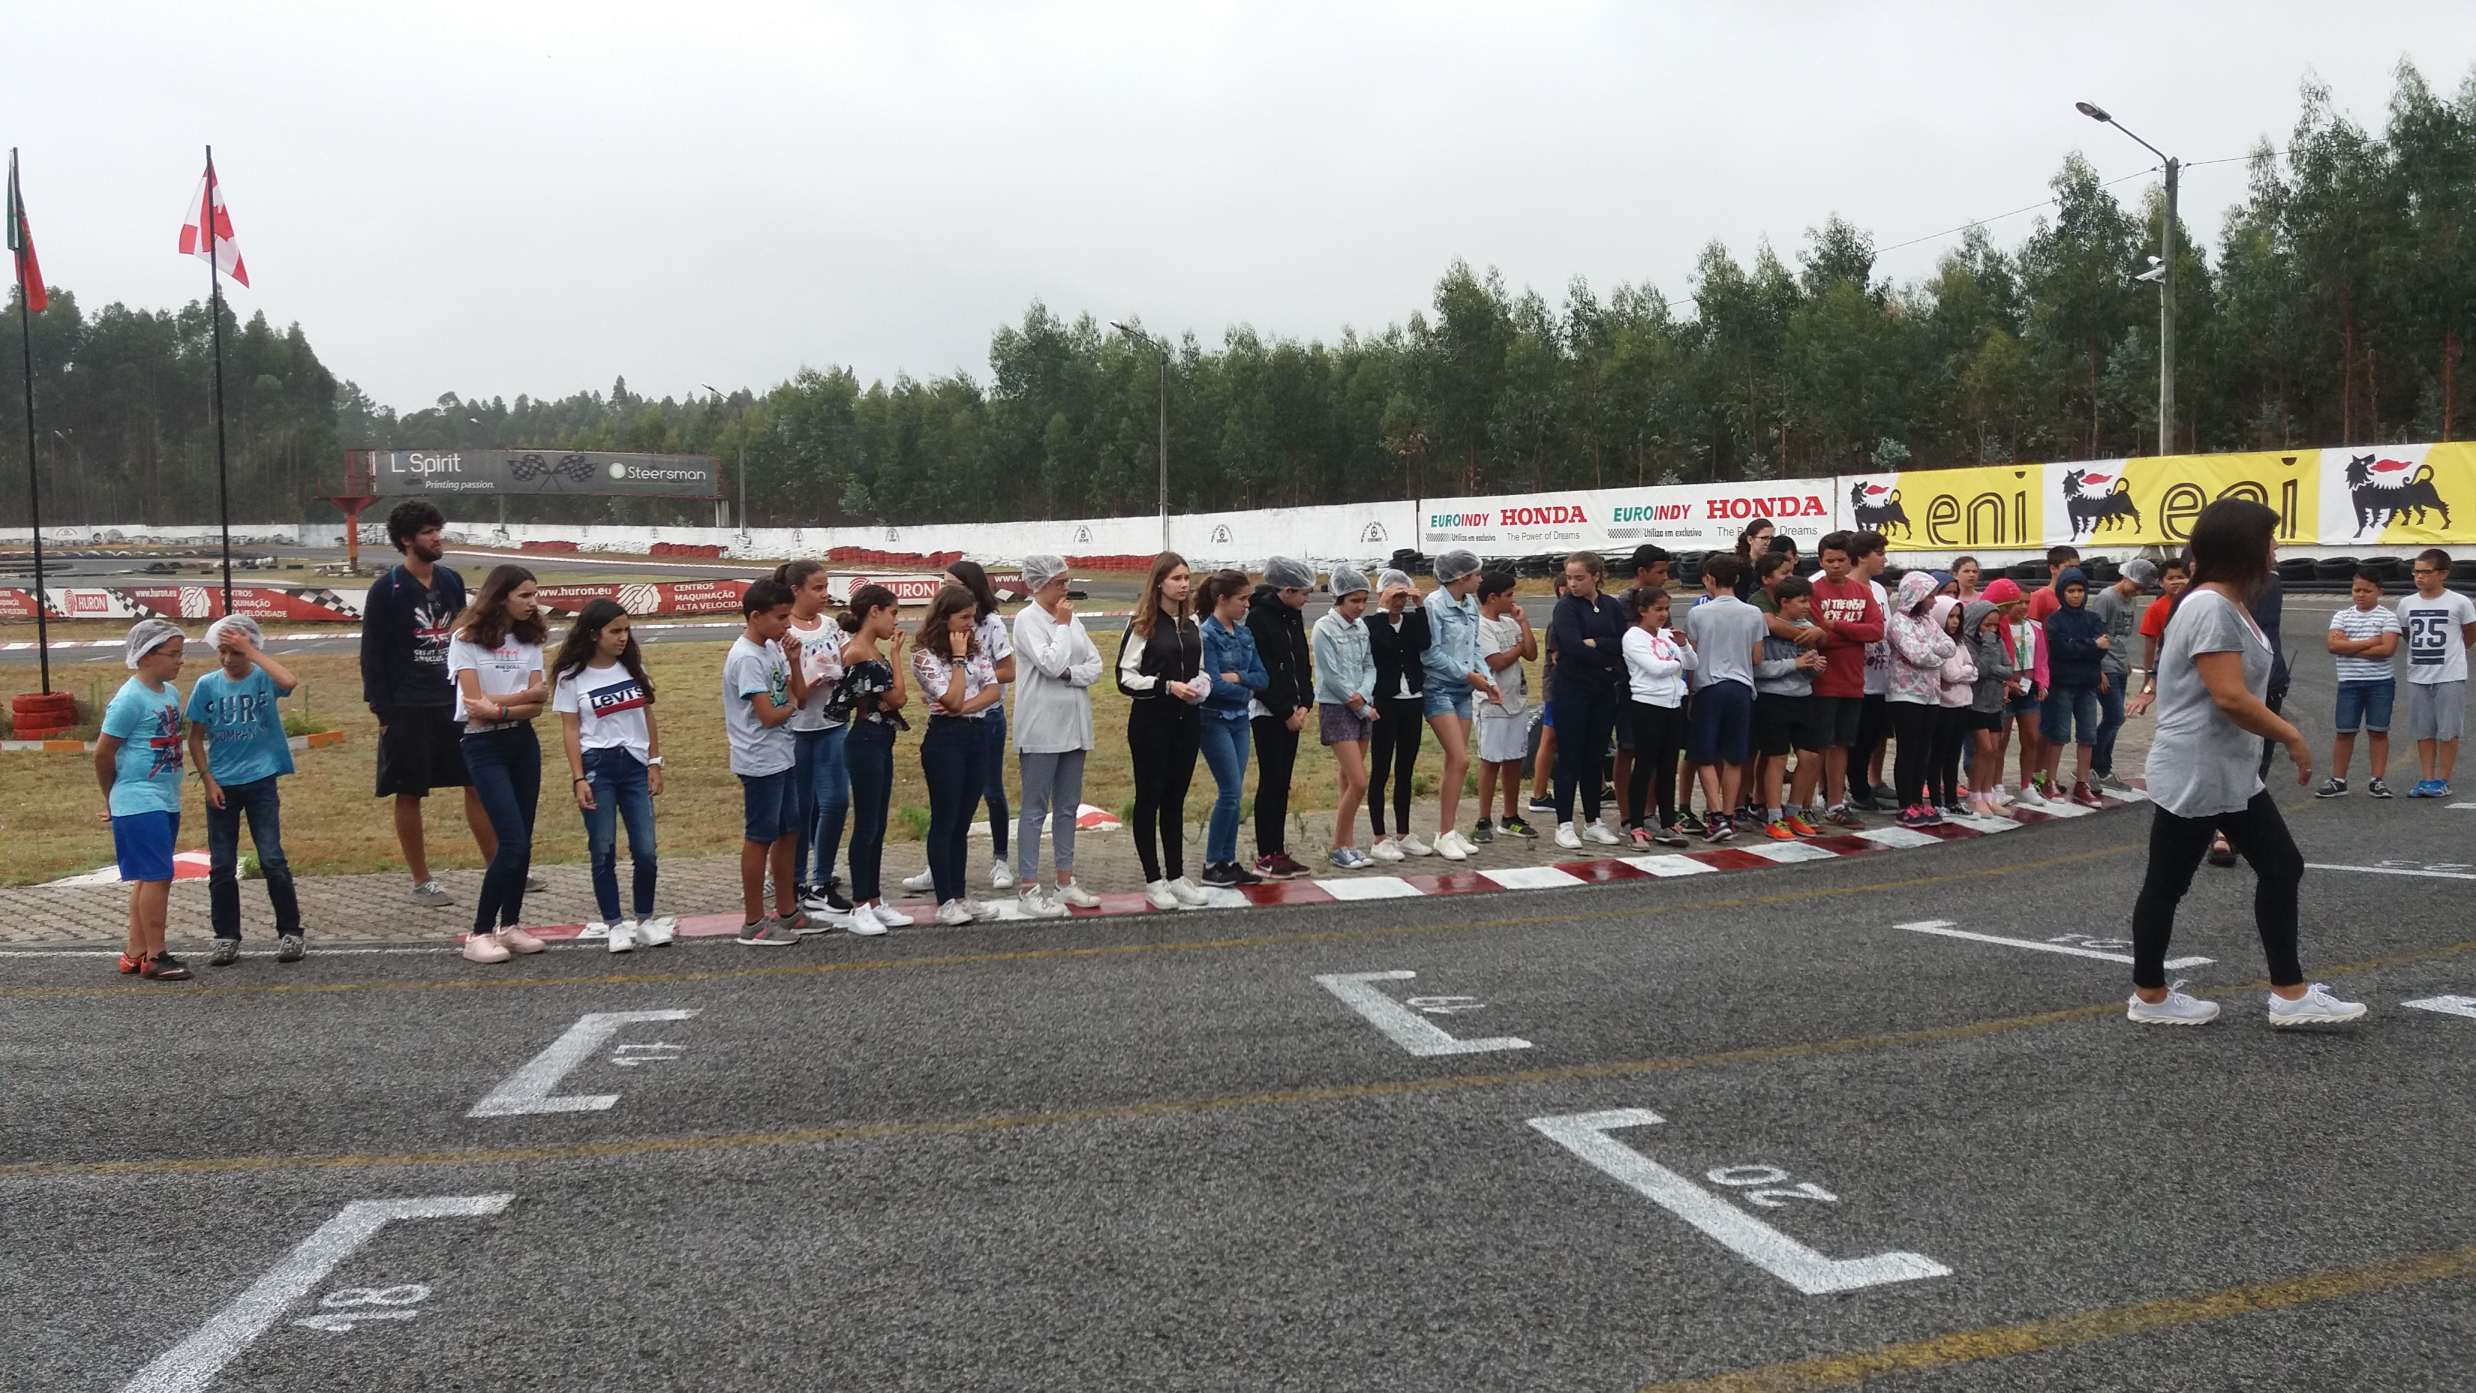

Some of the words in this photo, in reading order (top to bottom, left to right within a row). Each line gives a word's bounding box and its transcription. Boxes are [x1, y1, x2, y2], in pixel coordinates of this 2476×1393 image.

[391, 453, 406, 473] L
[409, 452, 462, 477] Spirit
[627, 466, 706, 481] Steersman
[425, 480, 460, 491] Printing
[460, 480, 495, 491] passion.
[1613, 503, 1692, 522] EUROINDY
[1706, 495, 1828, 519] HONDA
[1925, 471, 2027, 545] eni
[1431, 513, 1490, 528] EUROINDY
[1500, 505, 1588, 526] HONDA
[1507, 532, 1520, 542] The
[1521, 532, 1541, 541] Power
[1544, 531, 1552, 541] of
[1553, 530, 1580, 540] Dreams
[1717, 526, 1734, 537] The
[1779, 525, 1818, 536] Dreams
[674, 583, 715, 592] CENTROS
[674, 589, 736, 602] MAQUINAÇÃO
[79, 596, 107, 610] HURON
[675, 603, 699, 611] ALTA
[2410, 618, 2449, 648] 25
[1706, 1164, 1838, 1208] 20
